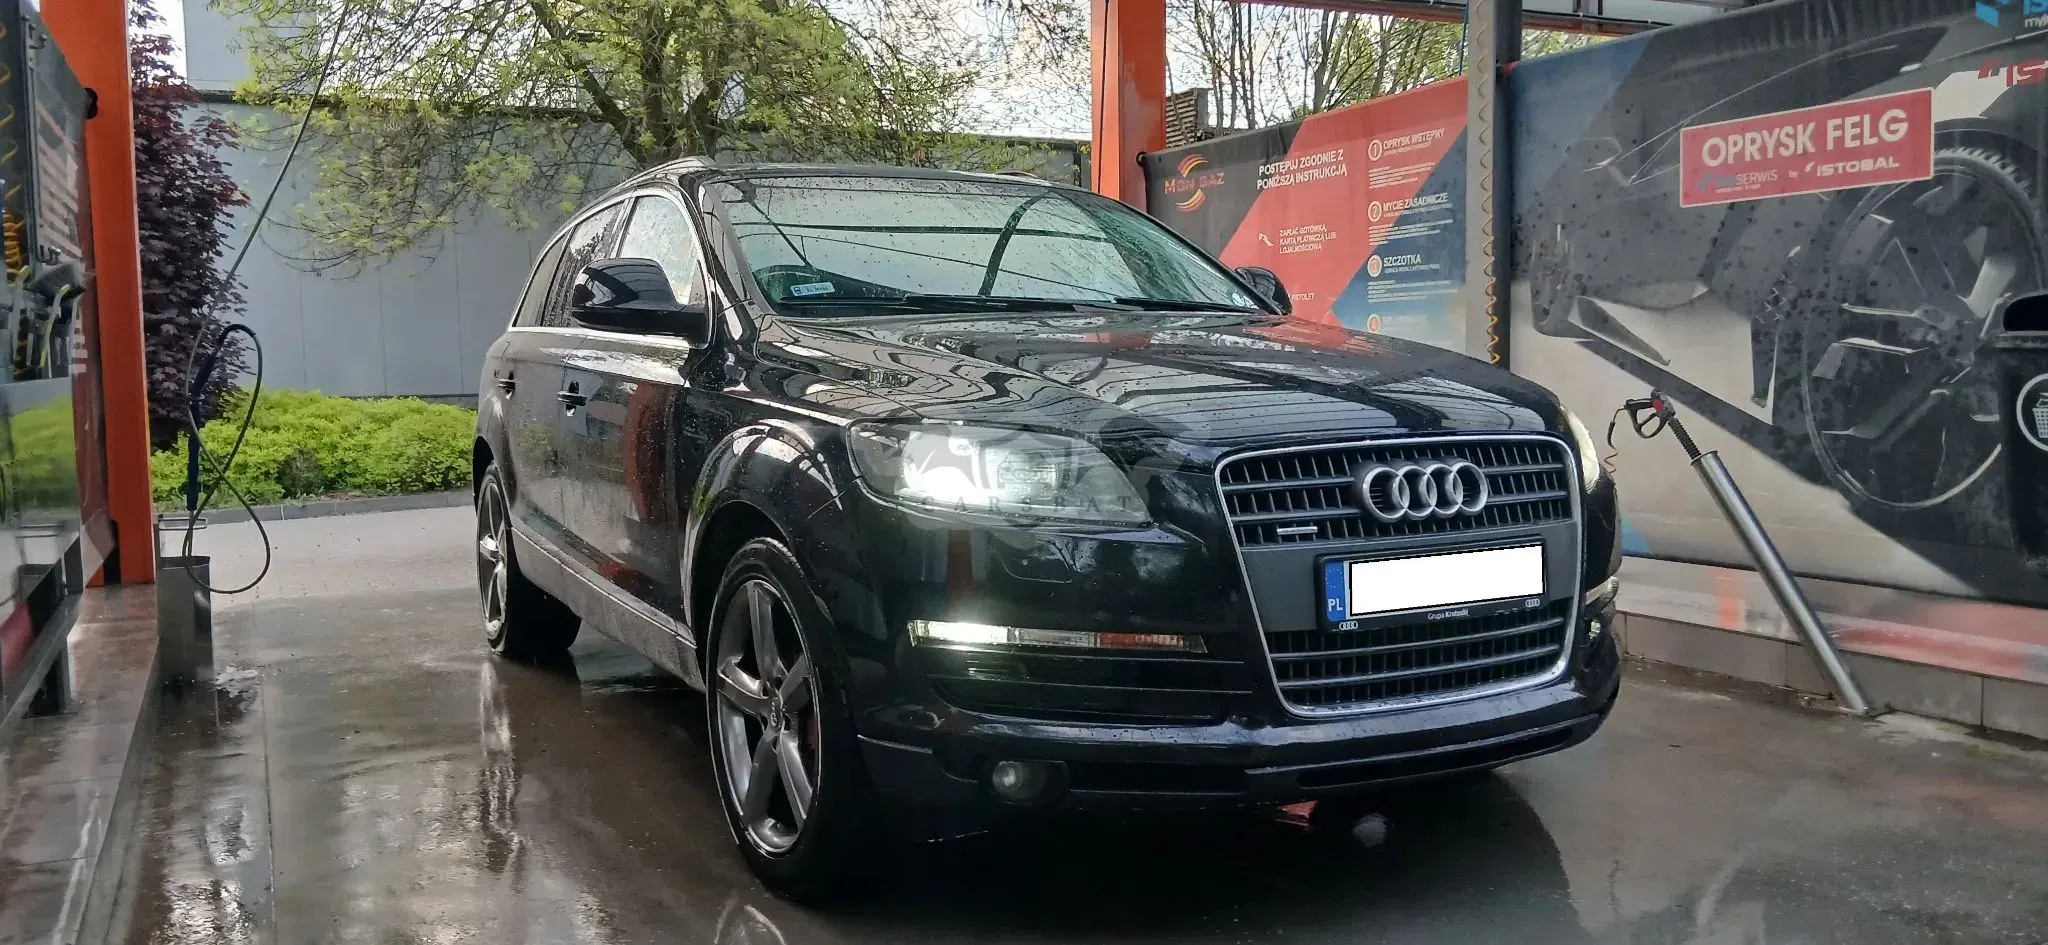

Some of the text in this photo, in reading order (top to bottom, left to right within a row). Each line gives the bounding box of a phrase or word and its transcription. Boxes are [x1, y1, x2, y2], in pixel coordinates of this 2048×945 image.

[1383, 135, 1411, 149] OPRYSK
[1701, 108, 1909, 167] OPRYSK FELG
[1258, 148, 1345, 177] POSTĘPUJ ZGODNIE Z
[1788, 170, 1799, 179] by
[1816, 155, 1900, 177] ISTOBAL
[1256, 174, 1296, 190] PONIŻSZĄ
[1295, 164, 1347, 184] INSTRUKCJĄ
[1382, 199, 1404, 213] MYCIE
[1404, 192, 1448, 210] ZASADNICZE
[1325, 231, 1337, 240] LUB
[1383, 254, 1422, 267] SZCZOTKA
[1327, 598, 1344, 612] PL
